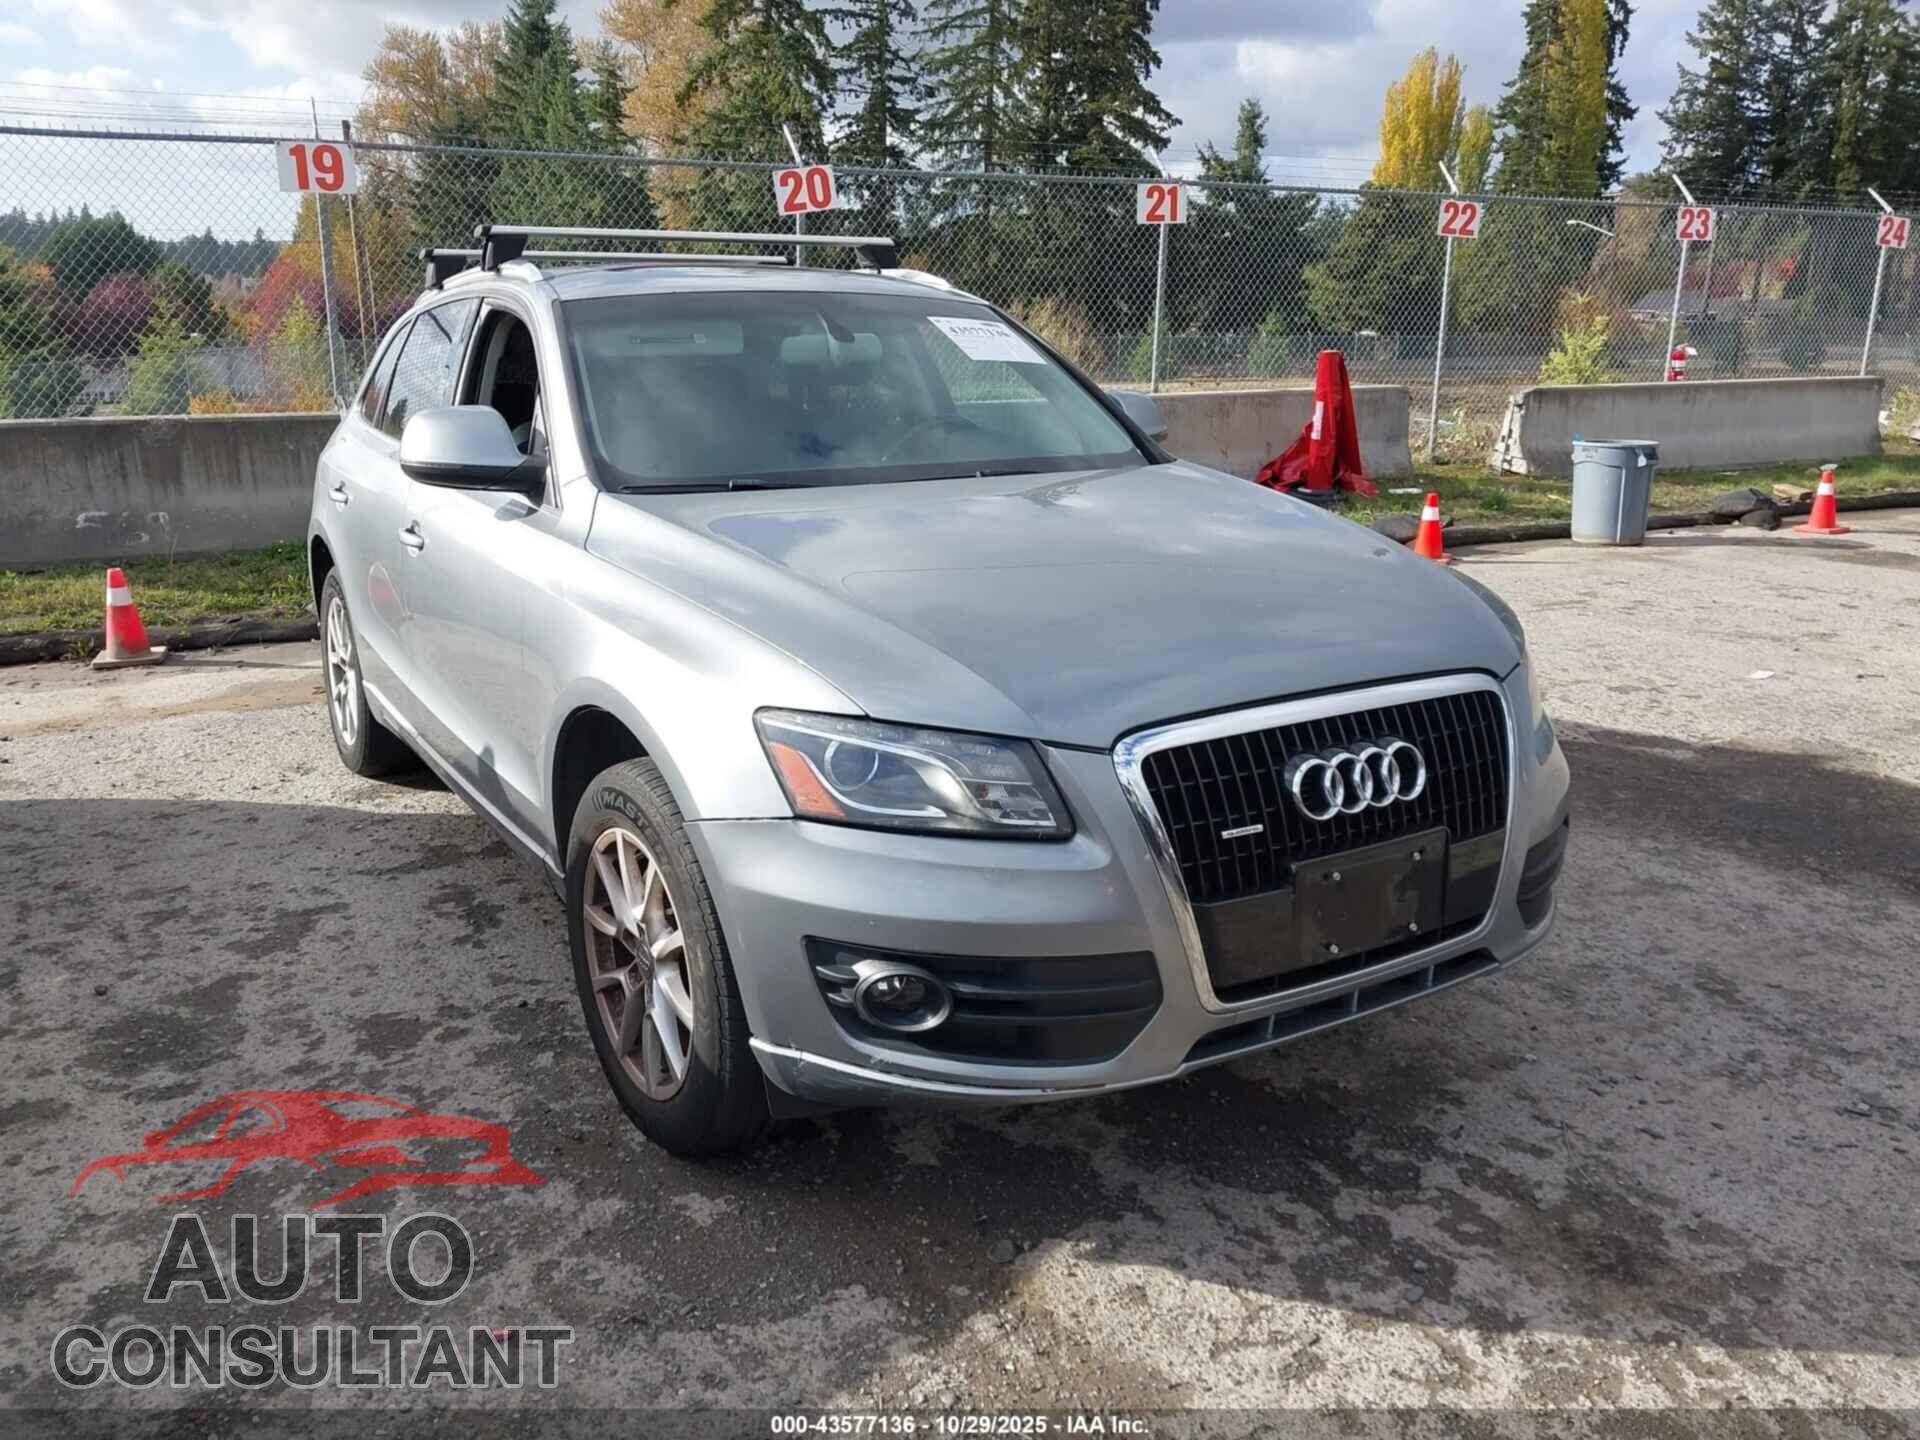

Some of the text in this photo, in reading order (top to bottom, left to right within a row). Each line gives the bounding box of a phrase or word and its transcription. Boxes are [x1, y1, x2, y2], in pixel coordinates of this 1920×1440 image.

[288, 144, 344, 193] 19
[779, 167, 833, 213] 20
[1145, 184, 1179, 222] 21
[1441, 202, 1477, 236] 22
[1679, 208, 1710, 239] 23
[1880, 217, 1907, 247] 24
